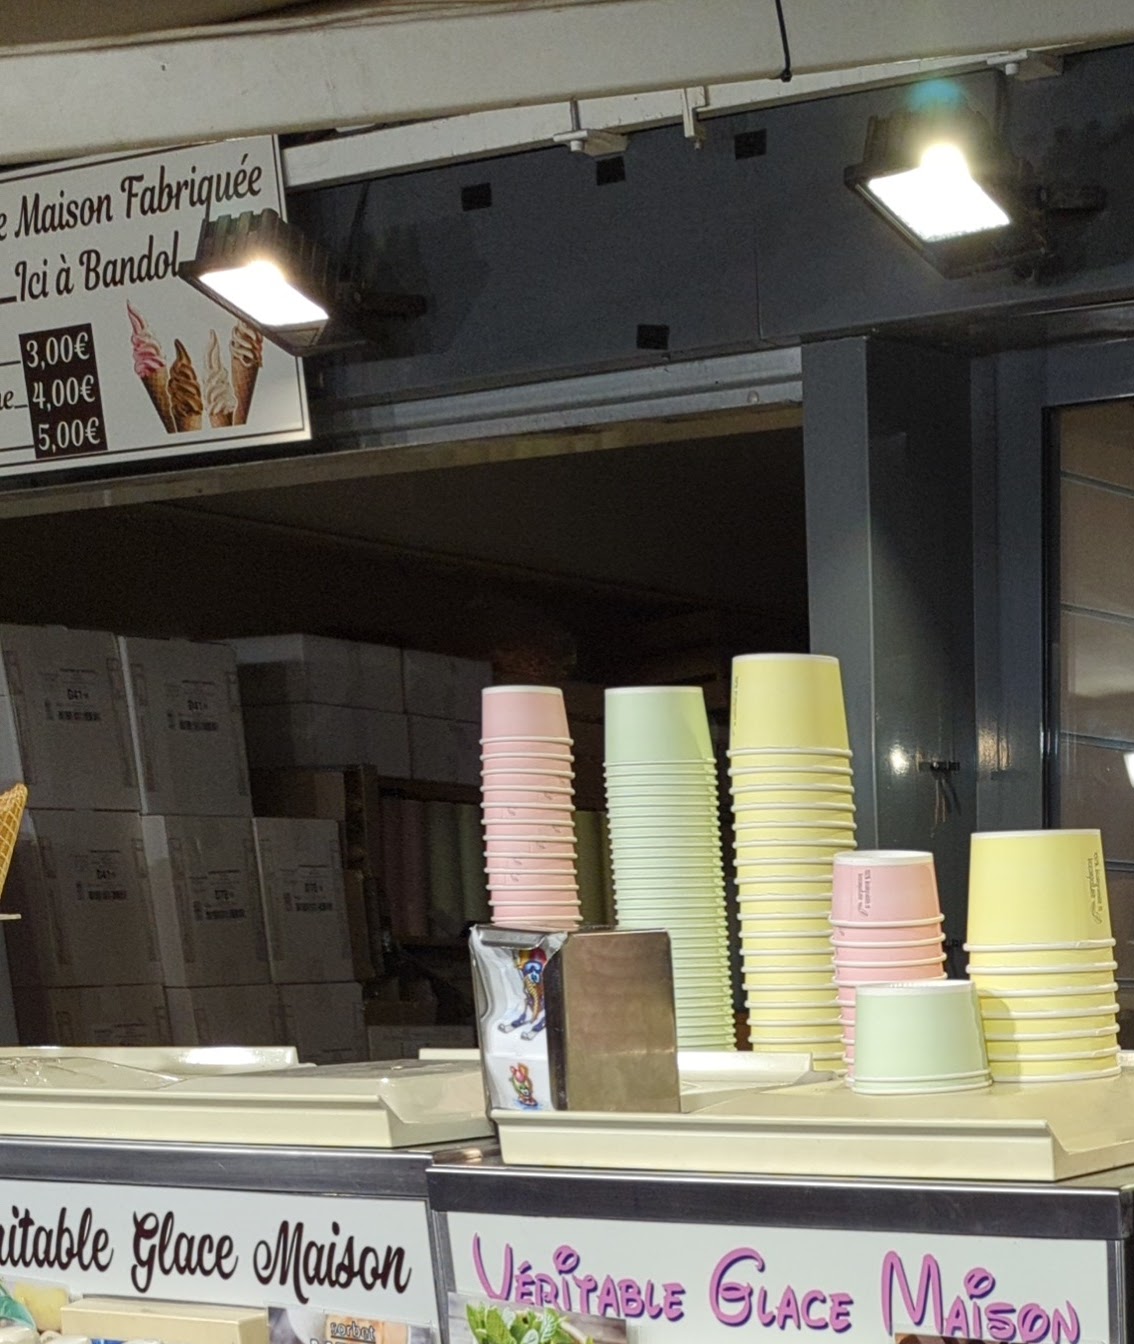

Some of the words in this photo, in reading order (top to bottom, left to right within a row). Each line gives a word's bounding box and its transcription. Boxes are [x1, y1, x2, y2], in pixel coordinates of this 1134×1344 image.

[14, 190, 113, 238] Maison
[120, 153, 263, 221] Fabriquée
[15, 259, 49, 301] Ici
[56, 254, 75, 295] à
[79, 230, 180, 292] Bandol
[26, 331, 91, 371] 3,00€
[32, 374, 96, 412] 4,00€
[37, 416, 101, 452] 5,00€
[131, 1210, 239, 1293] Glace
[254, 1220, 412, 1304] Maison
[330, 1321, 377, 1341] sorbet
